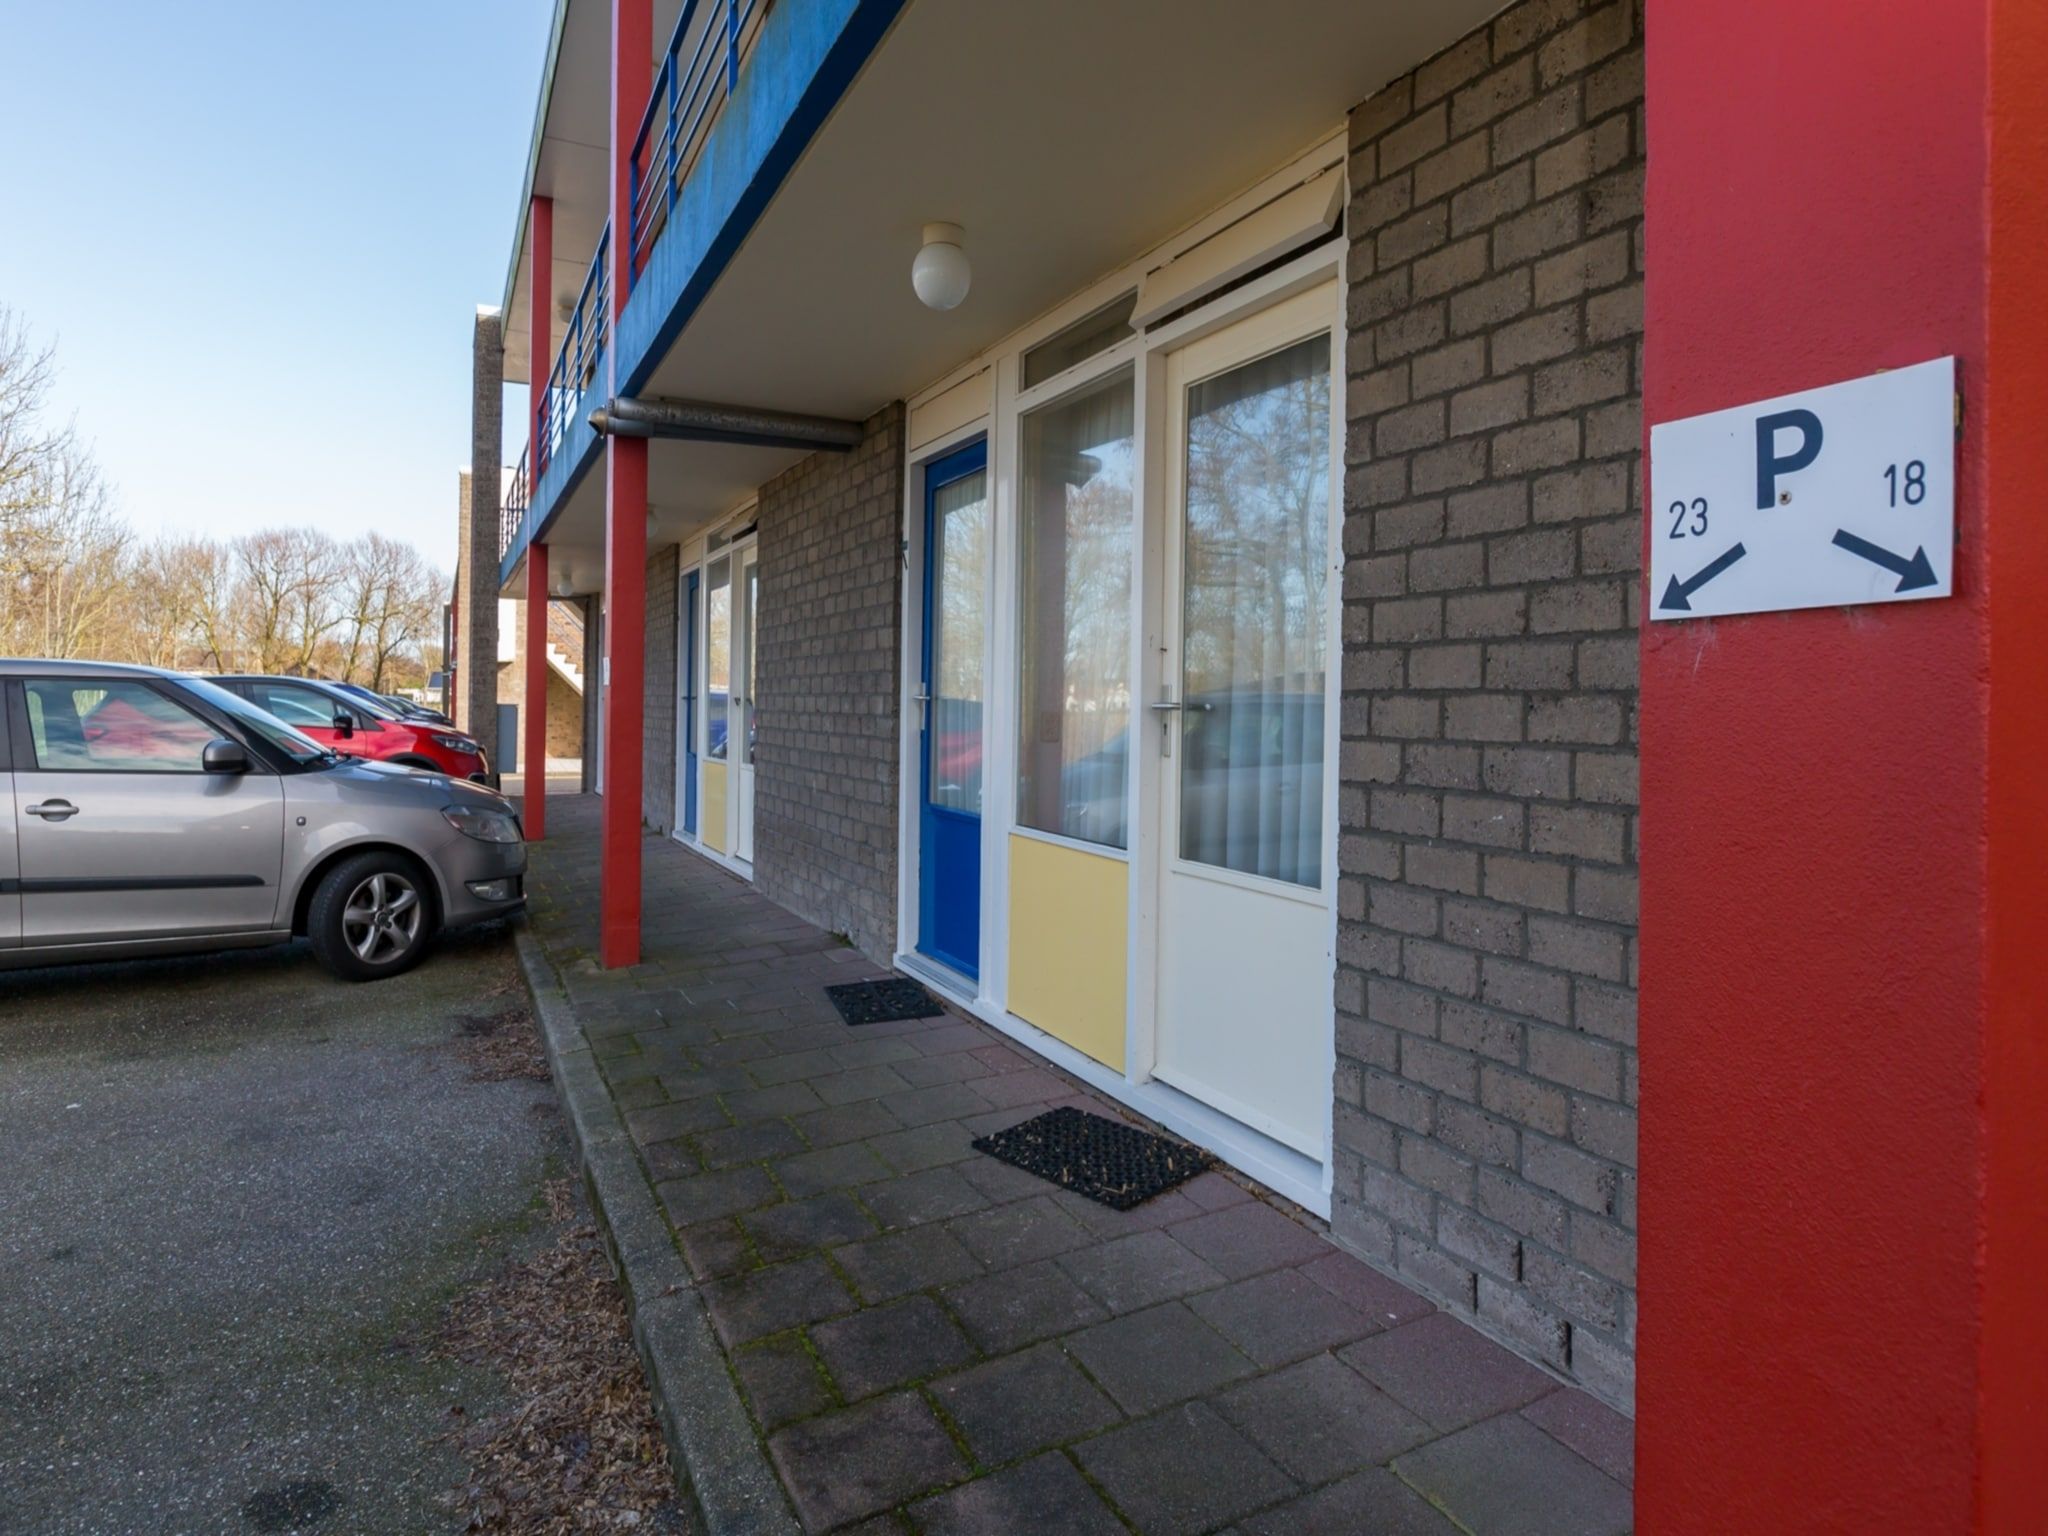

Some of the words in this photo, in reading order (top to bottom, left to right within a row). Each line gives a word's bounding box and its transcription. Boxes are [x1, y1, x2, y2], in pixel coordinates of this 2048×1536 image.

[1756, 408, 1823, 510] P
[1884, 460, 1926, 508] 18
[1669, 497, 1708, 539] 23
